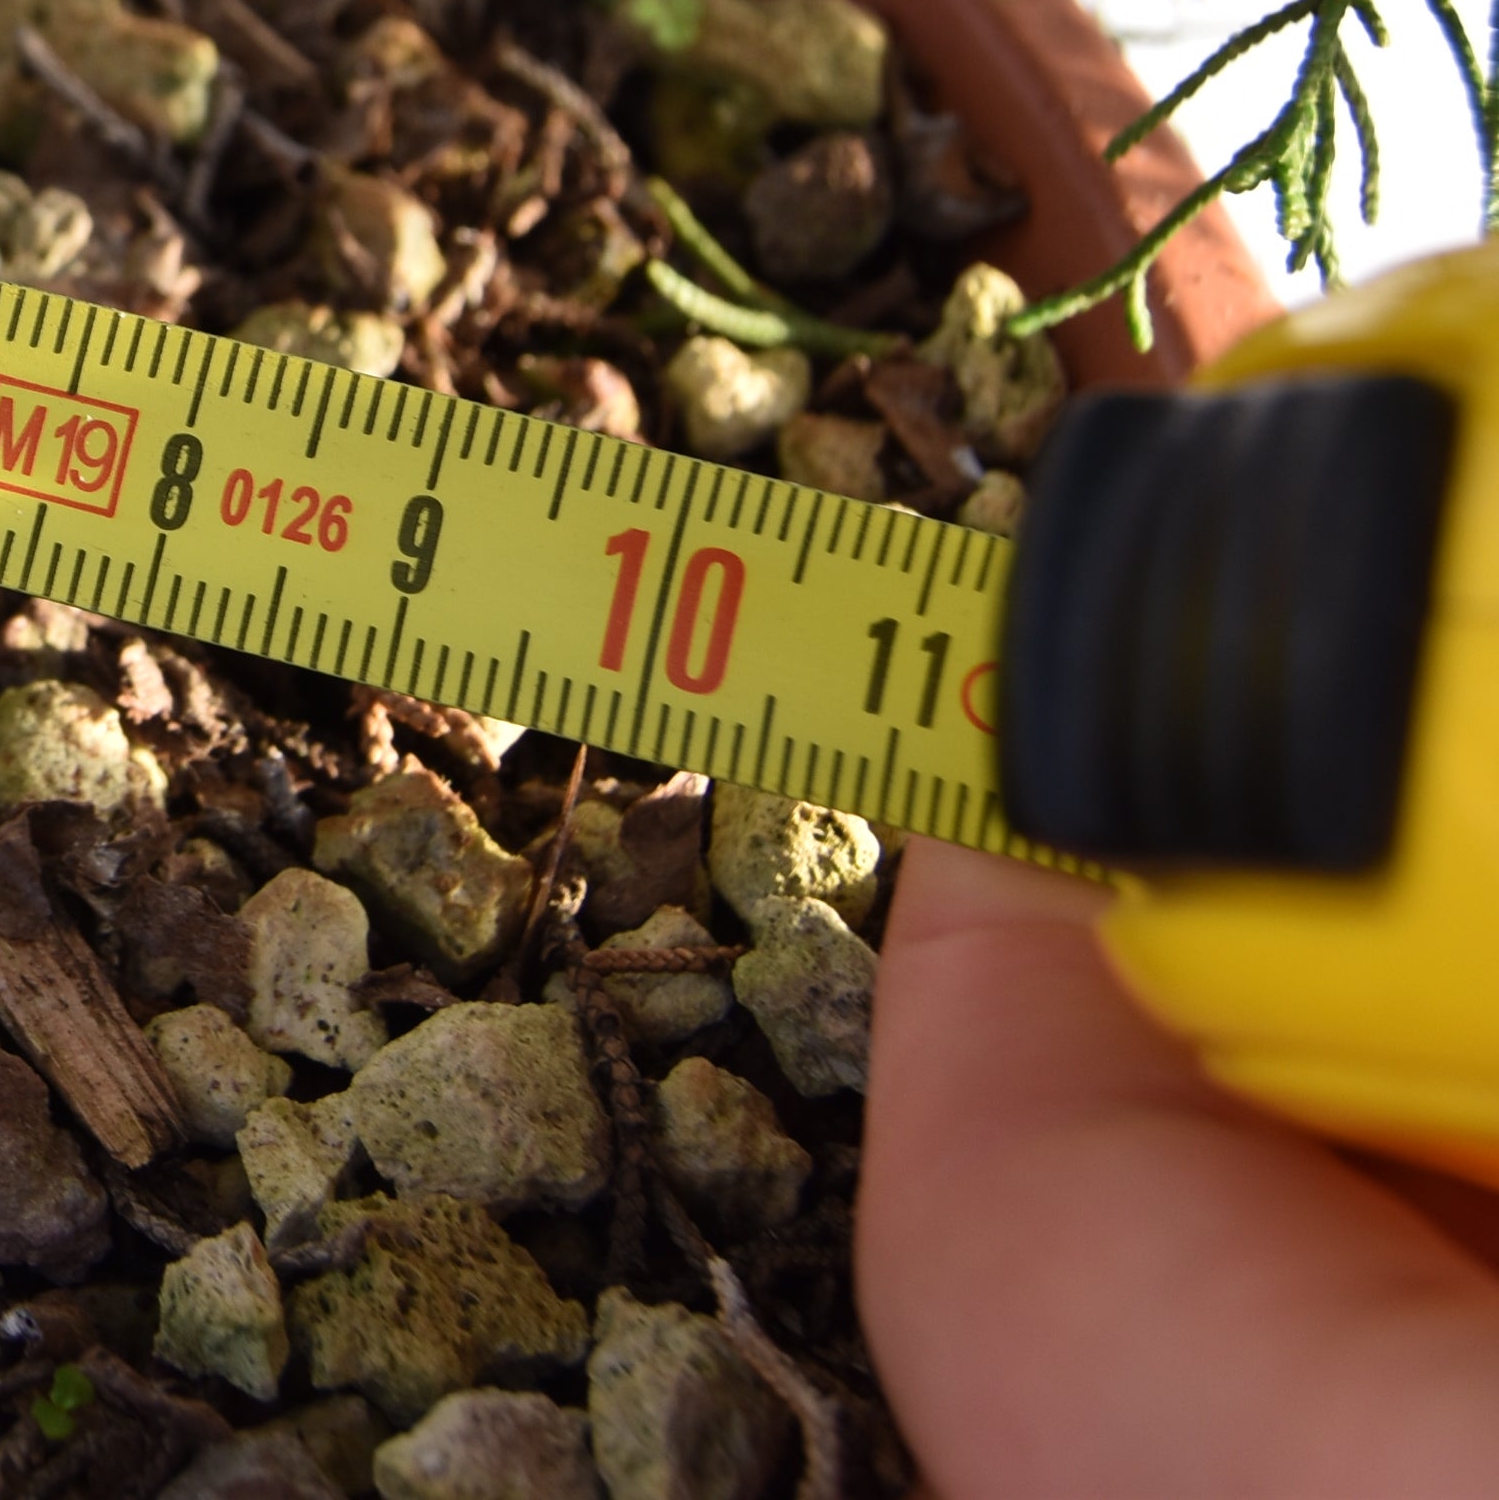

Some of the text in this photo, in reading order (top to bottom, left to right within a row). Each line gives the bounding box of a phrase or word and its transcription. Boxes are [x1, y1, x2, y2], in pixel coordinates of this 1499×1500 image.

[150, 433, 204, 531] 8
[219, 467, 354, 553] 0126
[390, 494, 444, 594] 9
[598, 528, 746, 695] 10
[863, 616, 951, 730] 11
